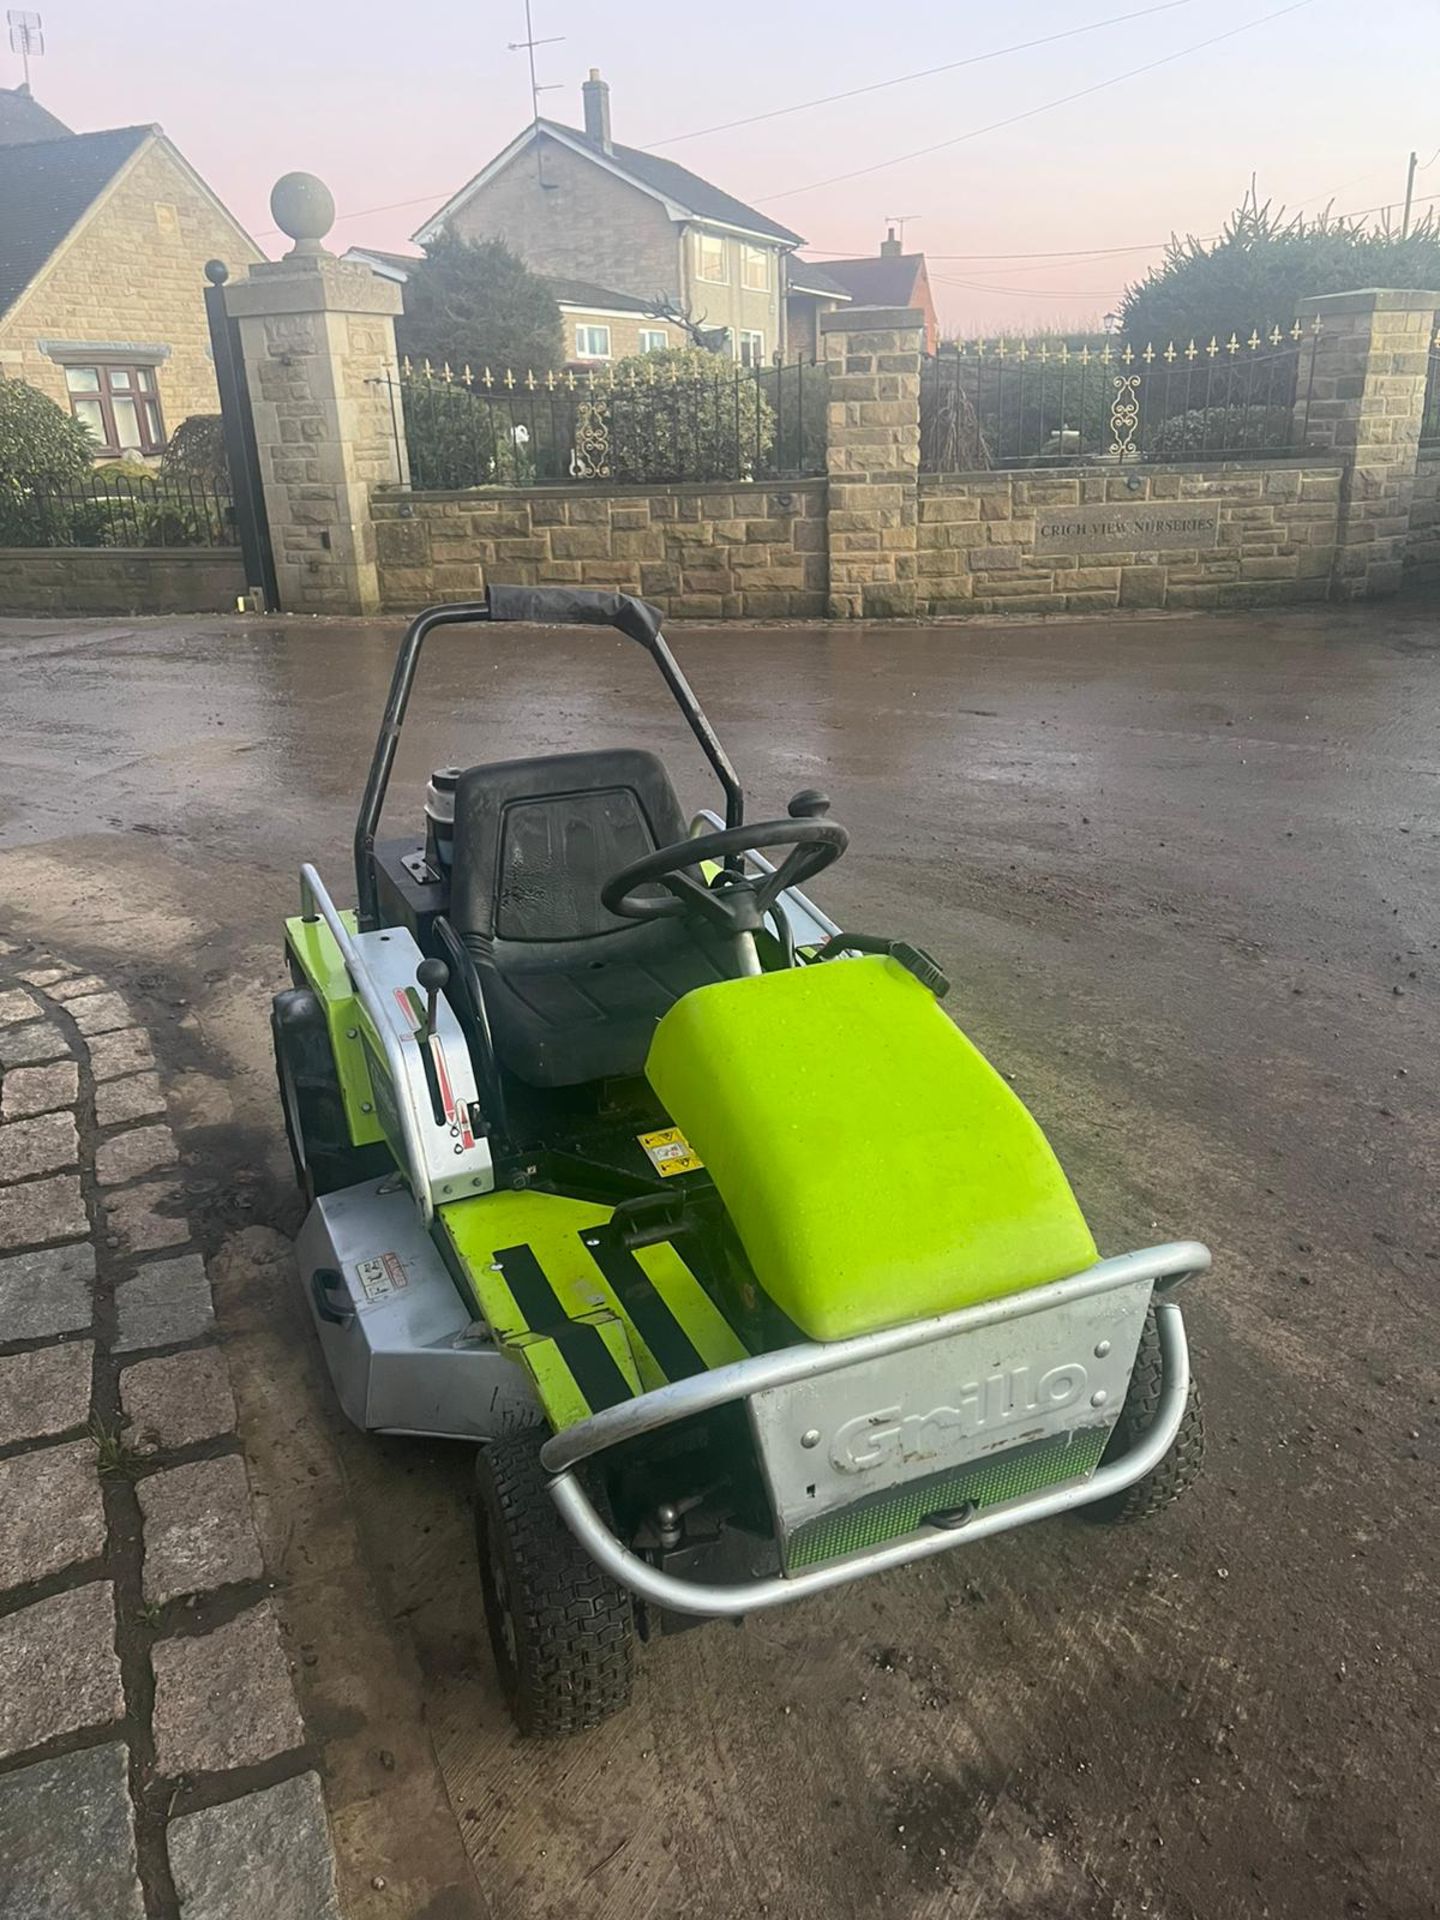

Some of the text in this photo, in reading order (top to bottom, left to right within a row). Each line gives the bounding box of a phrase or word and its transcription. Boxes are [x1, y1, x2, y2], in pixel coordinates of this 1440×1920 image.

[1040, 518, 1214, 538] CRICH VIEW NURSERIES
